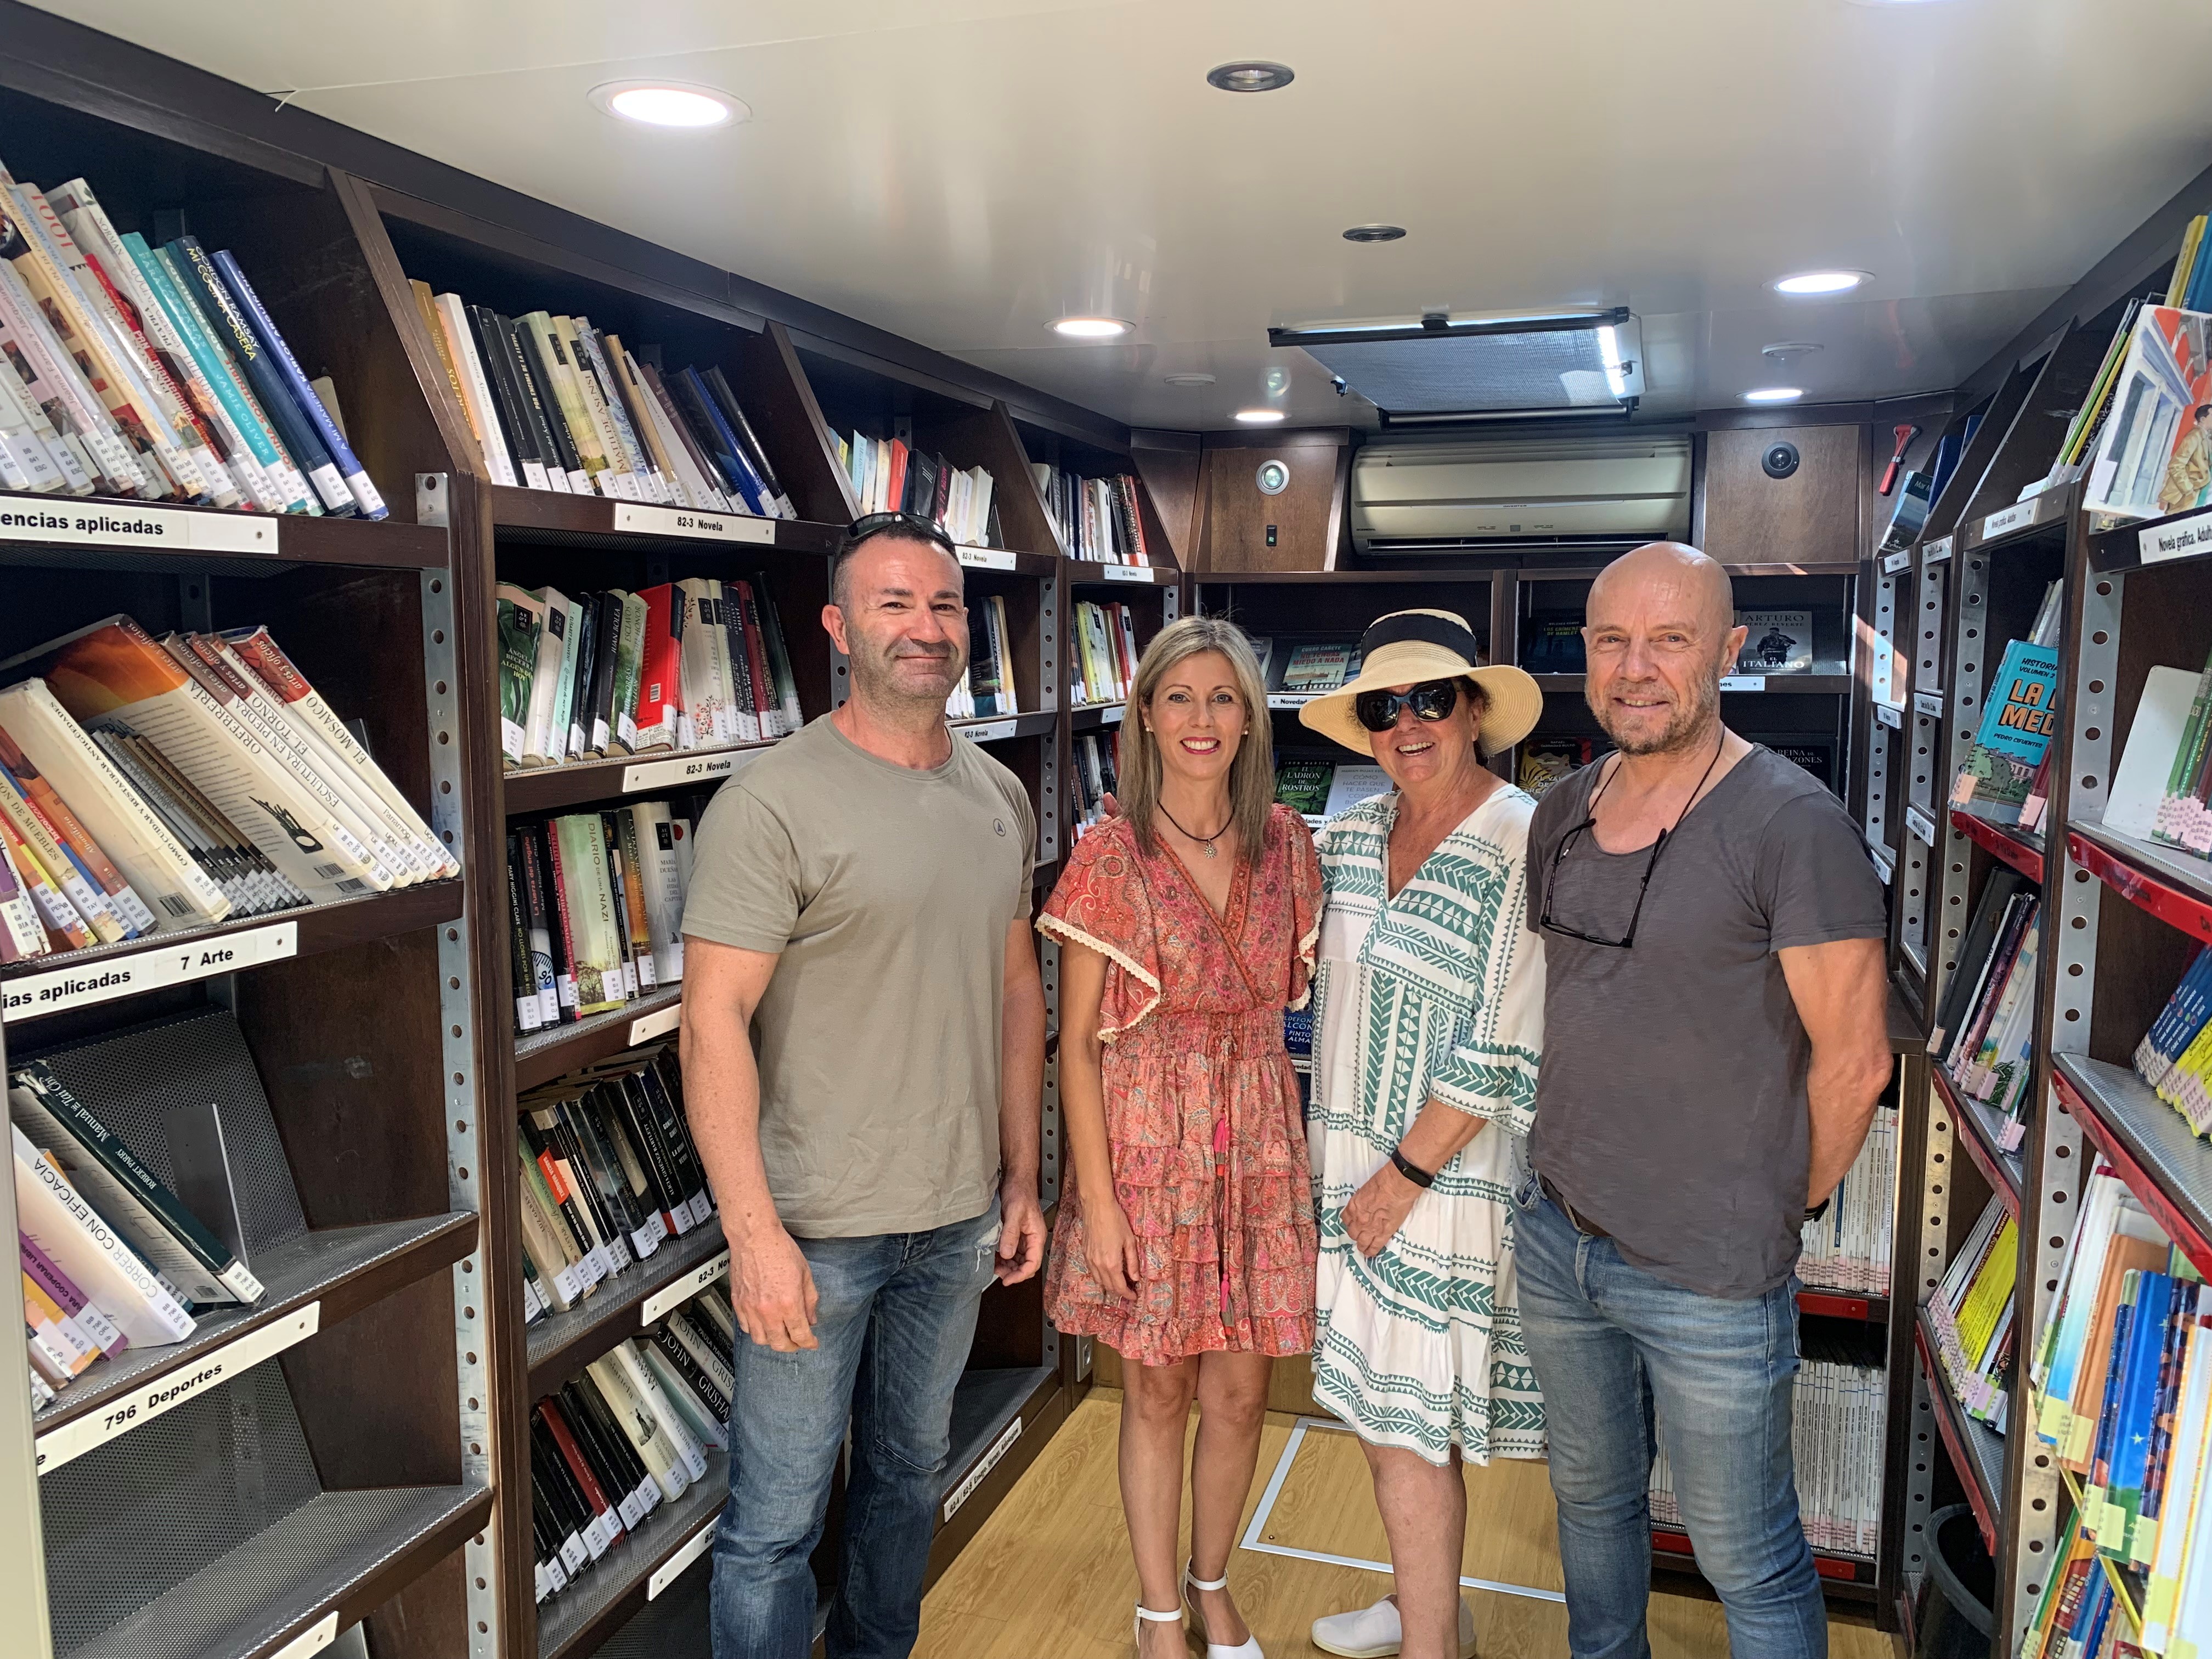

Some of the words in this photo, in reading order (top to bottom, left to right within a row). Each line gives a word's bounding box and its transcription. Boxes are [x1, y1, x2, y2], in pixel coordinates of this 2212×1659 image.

[31, 195, 73, 247] 1001
[97, 217, 124, 256] NORMAN
[161, 256, 208, 324] PARELLADA
[185, 245, 201, 264] MI
[193, 263, 235, 321] COCINA
[228, 321, 258, 362] CASERA
[191, 244, 232, 302] GORDON
[225, 302, 261, 351] RAMSAY
[236, 267, 281, 340] ARGUIÑANO
[203, 324, 224, 353] ADA
[278, 338, 307, 383] KARLOS
[517, 355, 524, 363] LA
[520, 363, 528, 373] DE
[523, 373, 536, 396] ENCIMA
[583, 373, 605, 416] ASENSI
[214, 372, 242, 411] JAMIE
[238, 411, 270, 457] OLIVER
[304, 382, 334, 428] MANERA
[532, 396, 541, 410] POR
[331, 428, 342, 442] MI
[600, 416, 627, 471] MATILDE
[1914, 481, 1925, 489] Mar
[76, 517, 163, 535] aplicadas
[677, 516, 694, 528] 82-3
[698, 519, 723, 532] Novela
[2159, 535, 2175, 552] Novela
[2177, 531, 2196, 551] gráfica.
[611, 607, 622, 631] BOLEA
[621, 606, 635, 642] ESCLAVOS
[1745, 614, 1804, 622] ARTURO
[610, 633, 619, 654] JUAN
[1742, 660, 1804, 669] ITALIANO
[2019, 667, 2049, 676] VOLUMEN
[2008, 678, 2045, 706] LA
[184, 679, 264, 758] ORFEBRERÍA
[230, 697, 275, 740] PIEDRA
[249, 695, 295, 740] TORNO
[301, 693, 359, 750] MOSAICO
[268, 735, 289, 755] EN
[289, 735, 310, 756] EL
[1993, 733, 2012, 741] PEDRO
[2013, 737, 2042, 748] CIFUENTES
[348, 745, 370, 766] EL
[686, 764, 702, 775] 82-3
[706, 760, 731, 772] Novela
[98, 759, 140, 810] RESTAURAR
[281, 750, 342, 809] ESCULTURA
[10, 800, 26, 817] DE
[22, 815, 60, 863] MUEBLES
[142, 811, 170, 845] CUIDAR
[166, 840, 189, 868] COMO
[588, 822, 601, 866] DIARIO
[595, 867, 601, 876] DE
[598, 893, 608, 922] NAZI
[509, 881, 518, 906] HIGGINS
[180, 956, 190, 970] 7
[200, 948, 234, 966] Arte
[38, 1070, 63, 1095] Chi
[55, 1087, 76, 1108] Tai
[74, 1105, 111, 1144] Manual
[114, 1146, 136, 1169] PARRY
[29, 1156, 91, 1221] EFICACIA
[132, 1164, 157, 1190] ROBERT
[523, 1194, 539, 1219] GABÁS
[83, 1216, 117, 1251] CON
[535, 1217, 546, 1233] LUZ
[109, 1246, 161, 1300] CORRER
[698, 1267, 714, 1283] 82-3
[718, 1258, 730, 1273] Nov
[659, 1330, 693, 1370] JOHN
[696, 1327, 714, 1348] PAULA
[711, 1345, 735, 1375] HAWKINS
[104, 1404, 137, 1430] 796
[148, 1363, 222, 1410] Deportes
